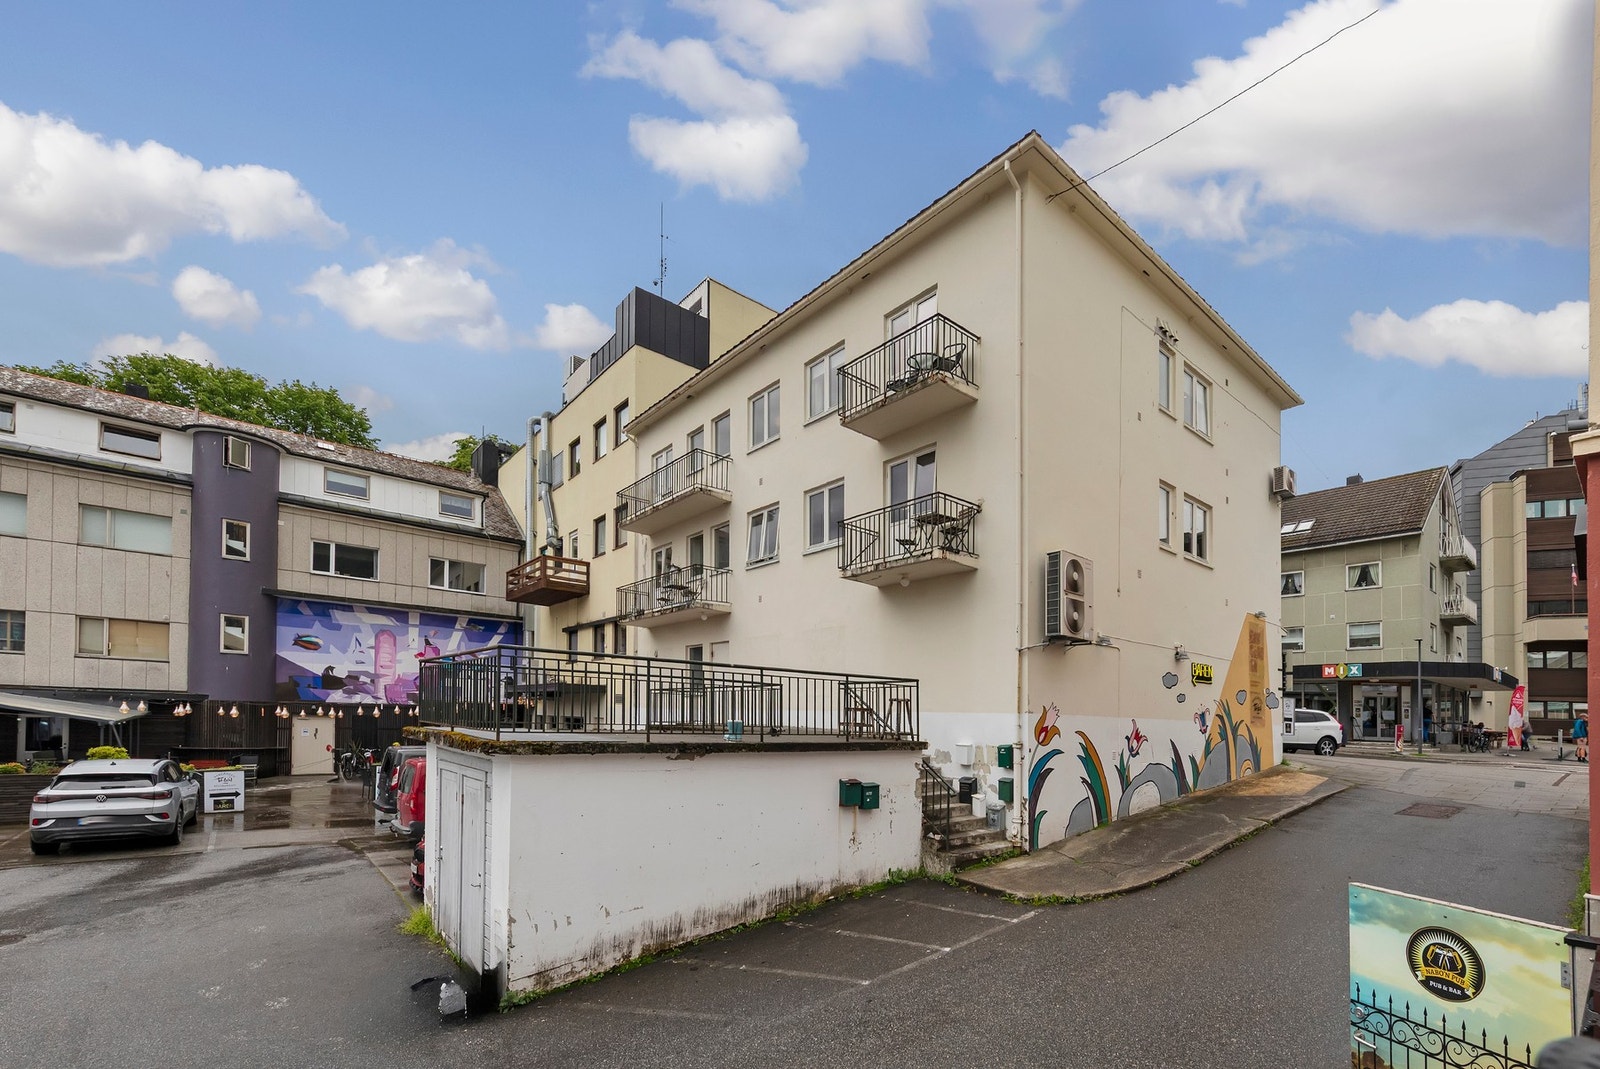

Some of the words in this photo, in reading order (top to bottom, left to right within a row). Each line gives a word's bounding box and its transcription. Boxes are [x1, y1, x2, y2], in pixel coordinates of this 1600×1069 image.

[1192, 662, 1214, 678] BAREN
[1324, 665, 1360, 676] MIX
[1451, 974, 1465, 986] PUB
[1429, 980, 1442, 988] PUB
[1449, 987, 1462, 995] BAR
